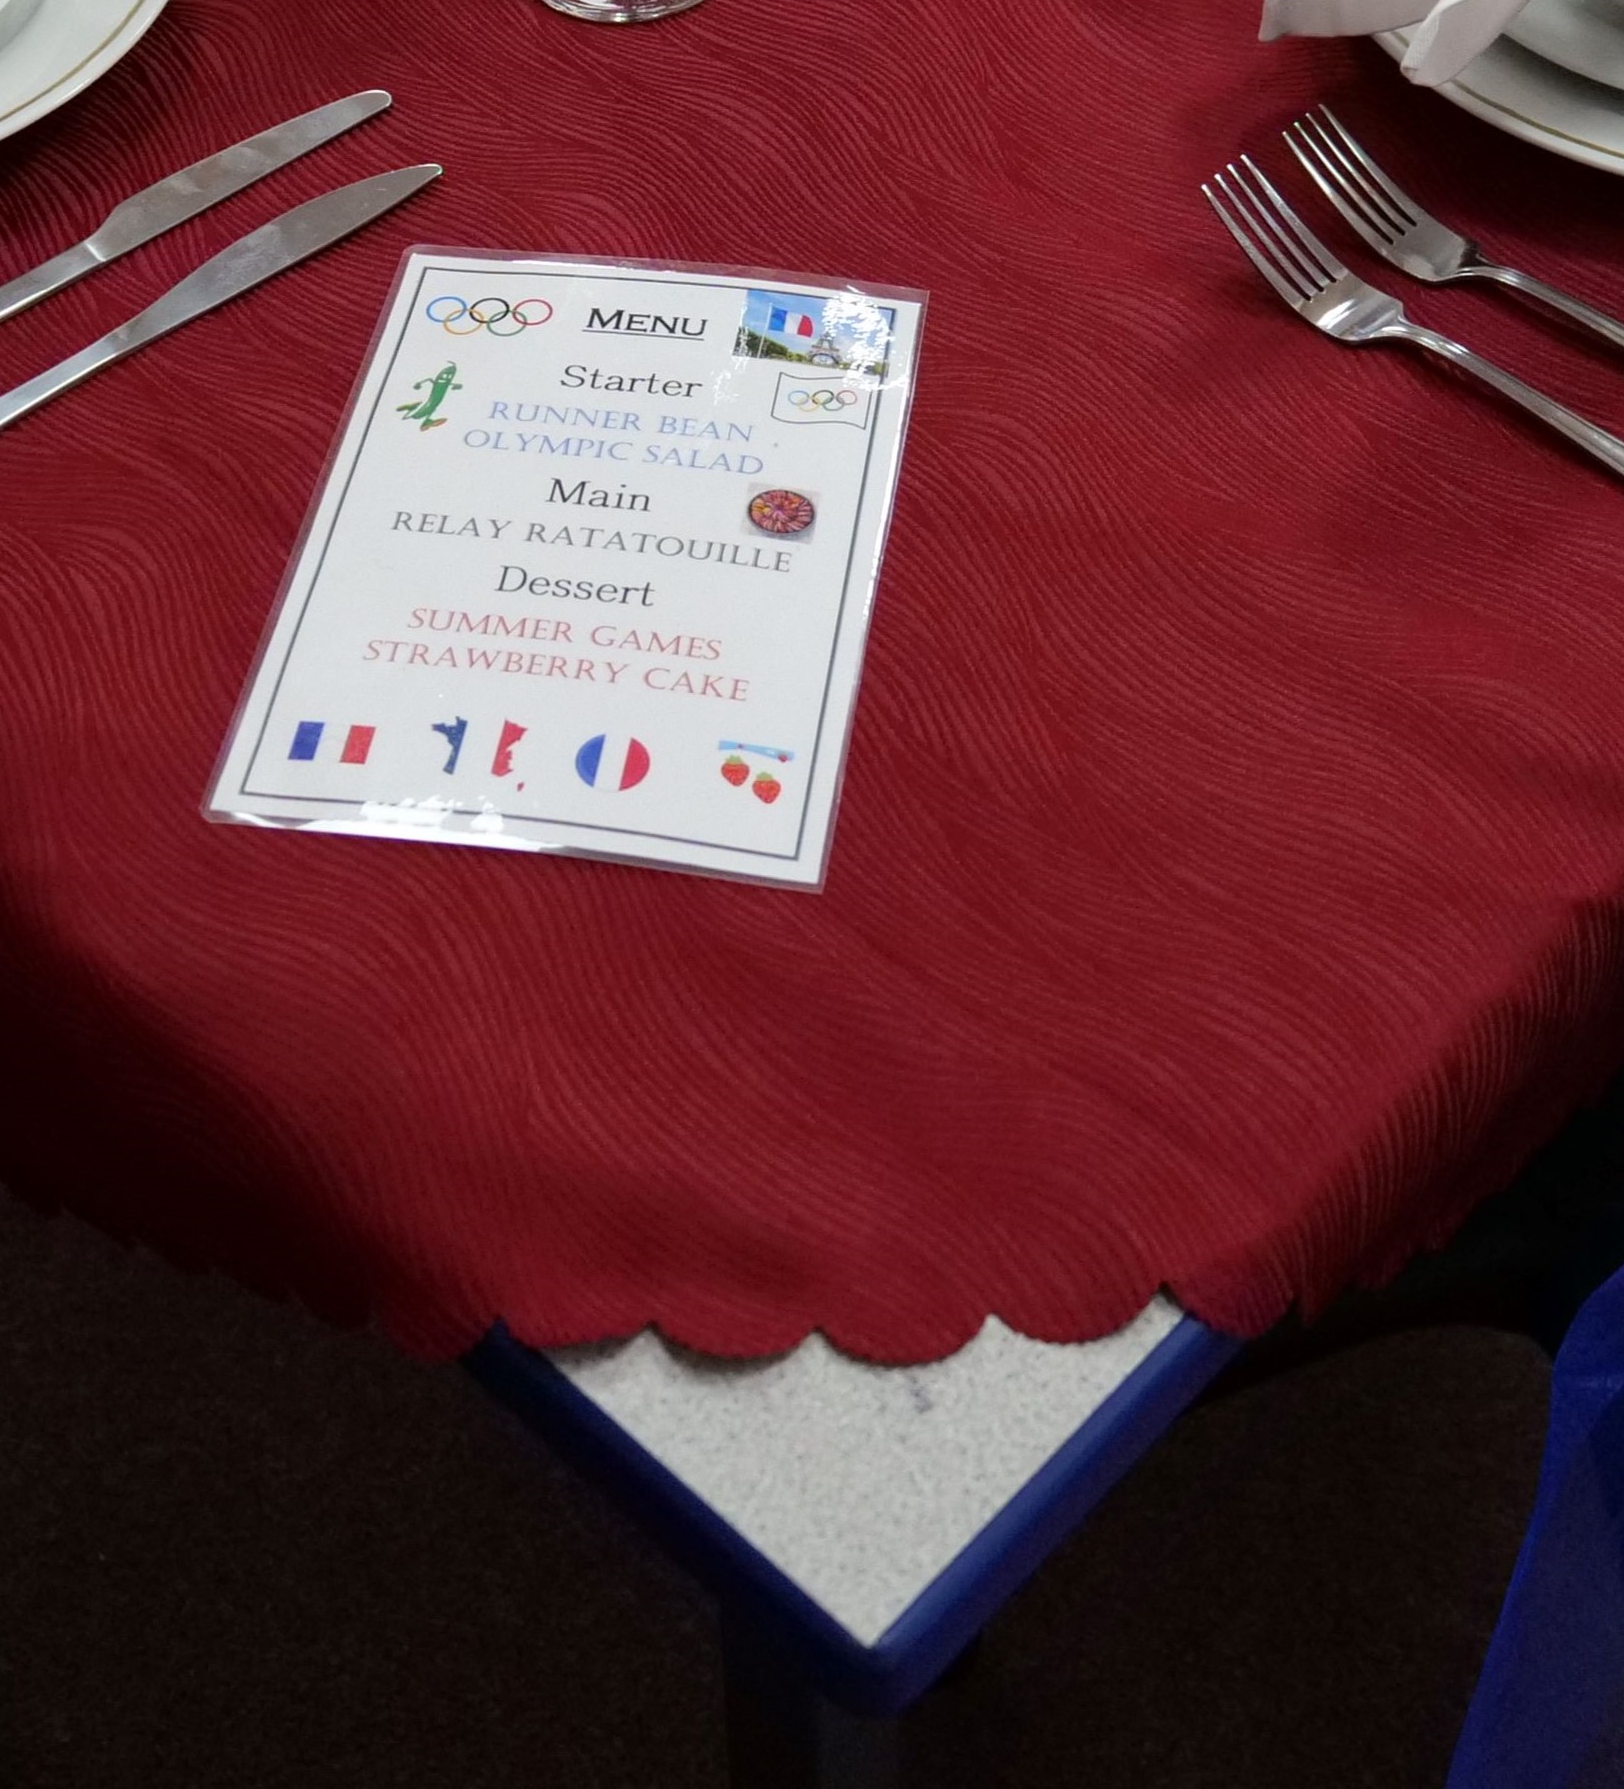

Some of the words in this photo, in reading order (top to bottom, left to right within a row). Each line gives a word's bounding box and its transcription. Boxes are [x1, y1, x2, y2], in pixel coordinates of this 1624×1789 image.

[583, 308, 708, 339] MENU
[560, 365, 703, 398] Starter
[488, 401, 641, 432] RUNNER
[657, 415, 753, 443] BEAN
[463, 429, 633, 461] OLYMPIC
[642, 444, 764, 476] SALAD
[544, 477, 651, 512] Main
[391, 511, 512, 540] RELAY
[524, 521, 793, 573] RATATOUILLE
[494, 564, 656, 608] Dessert
[407, 608, 574, 644] SUMMER
[590, 625, 723, 661] GAMES
[363, 639, 630, 685] STRAWBERRY
[642, 667, 751, 702] CAKE
